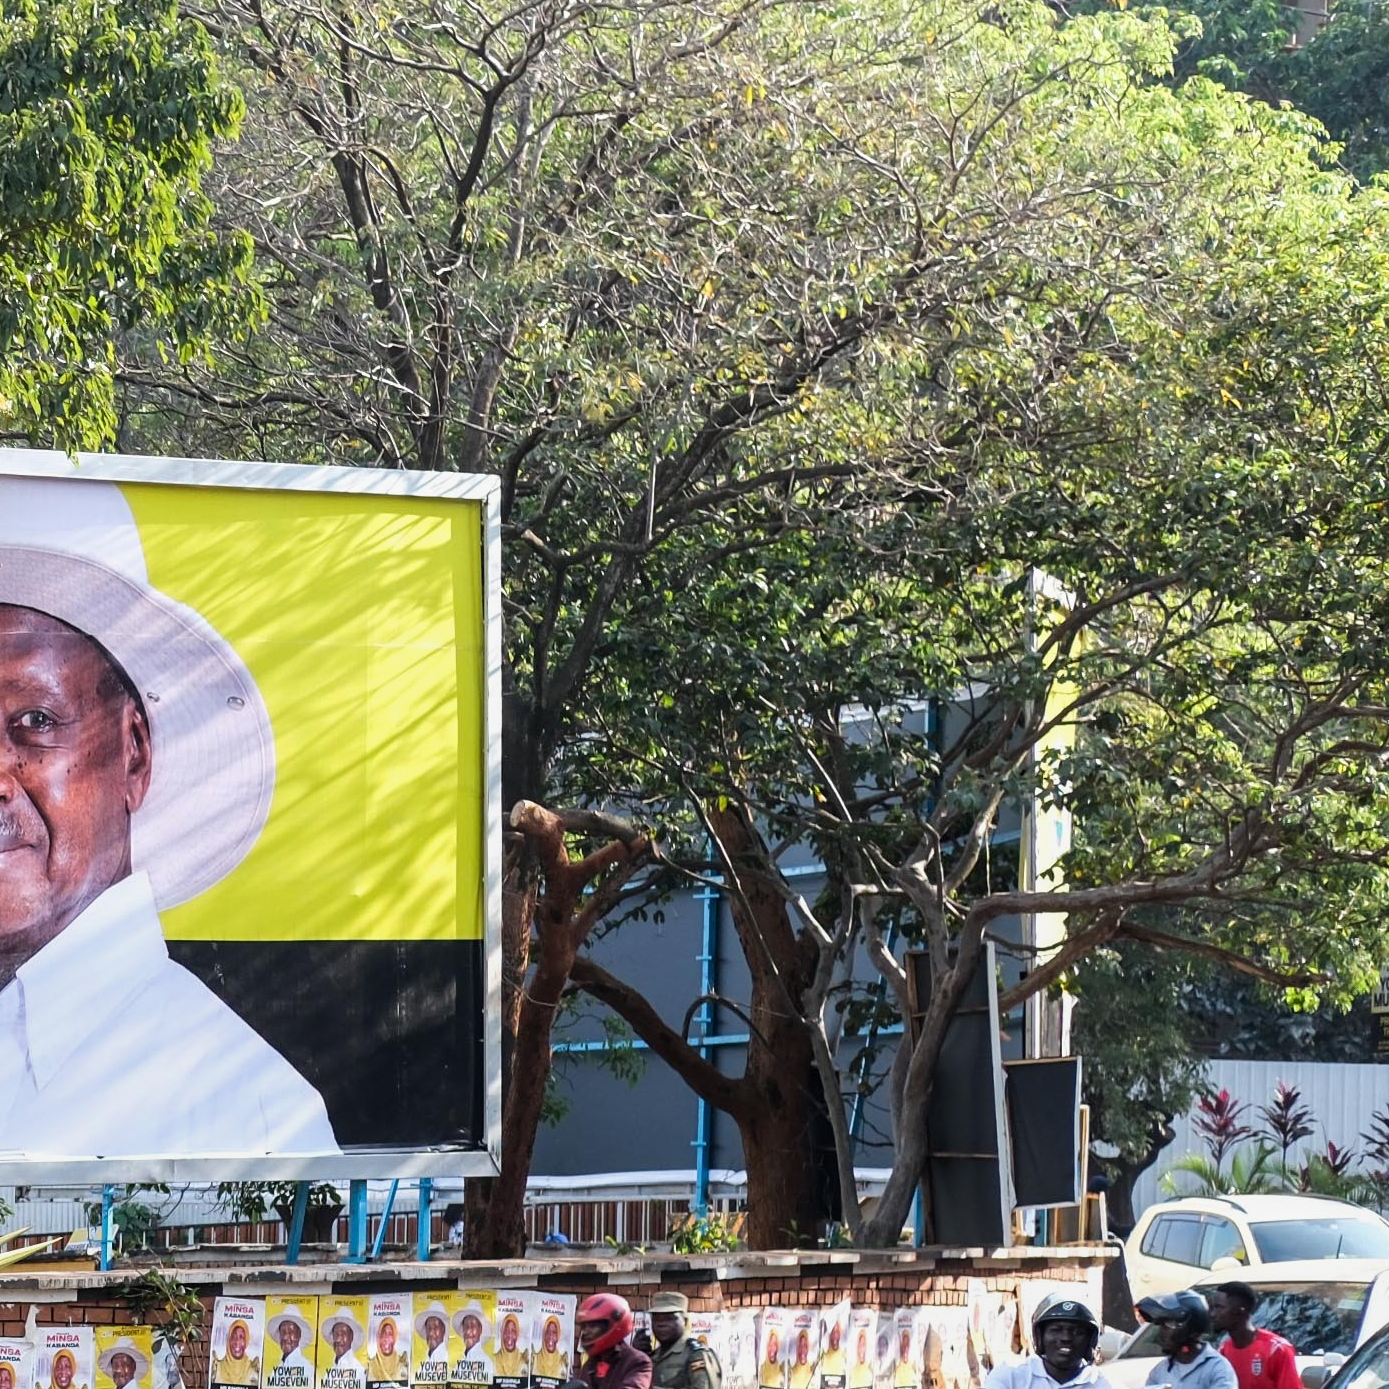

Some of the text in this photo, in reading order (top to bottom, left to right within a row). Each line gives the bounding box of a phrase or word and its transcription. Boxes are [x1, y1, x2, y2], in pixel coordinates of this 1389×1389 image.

[225, 1305, 254, 1314] MINSA
[374, 1303, 400, 1311] MINSA
[273, 1366, 305, 1376] YOWERI
[420, 1361, 447, 1371] YOWER
[326, 1367, 356, 1379] YOWERI
[415, 1371, 447, 1382] MUSEVE
[451, 1371, 488, 1382] MUSEVENI
[267, 1376, 308, 1387] MUSEVENI
[321, 1378, 360, 1389] MUSEVENI
